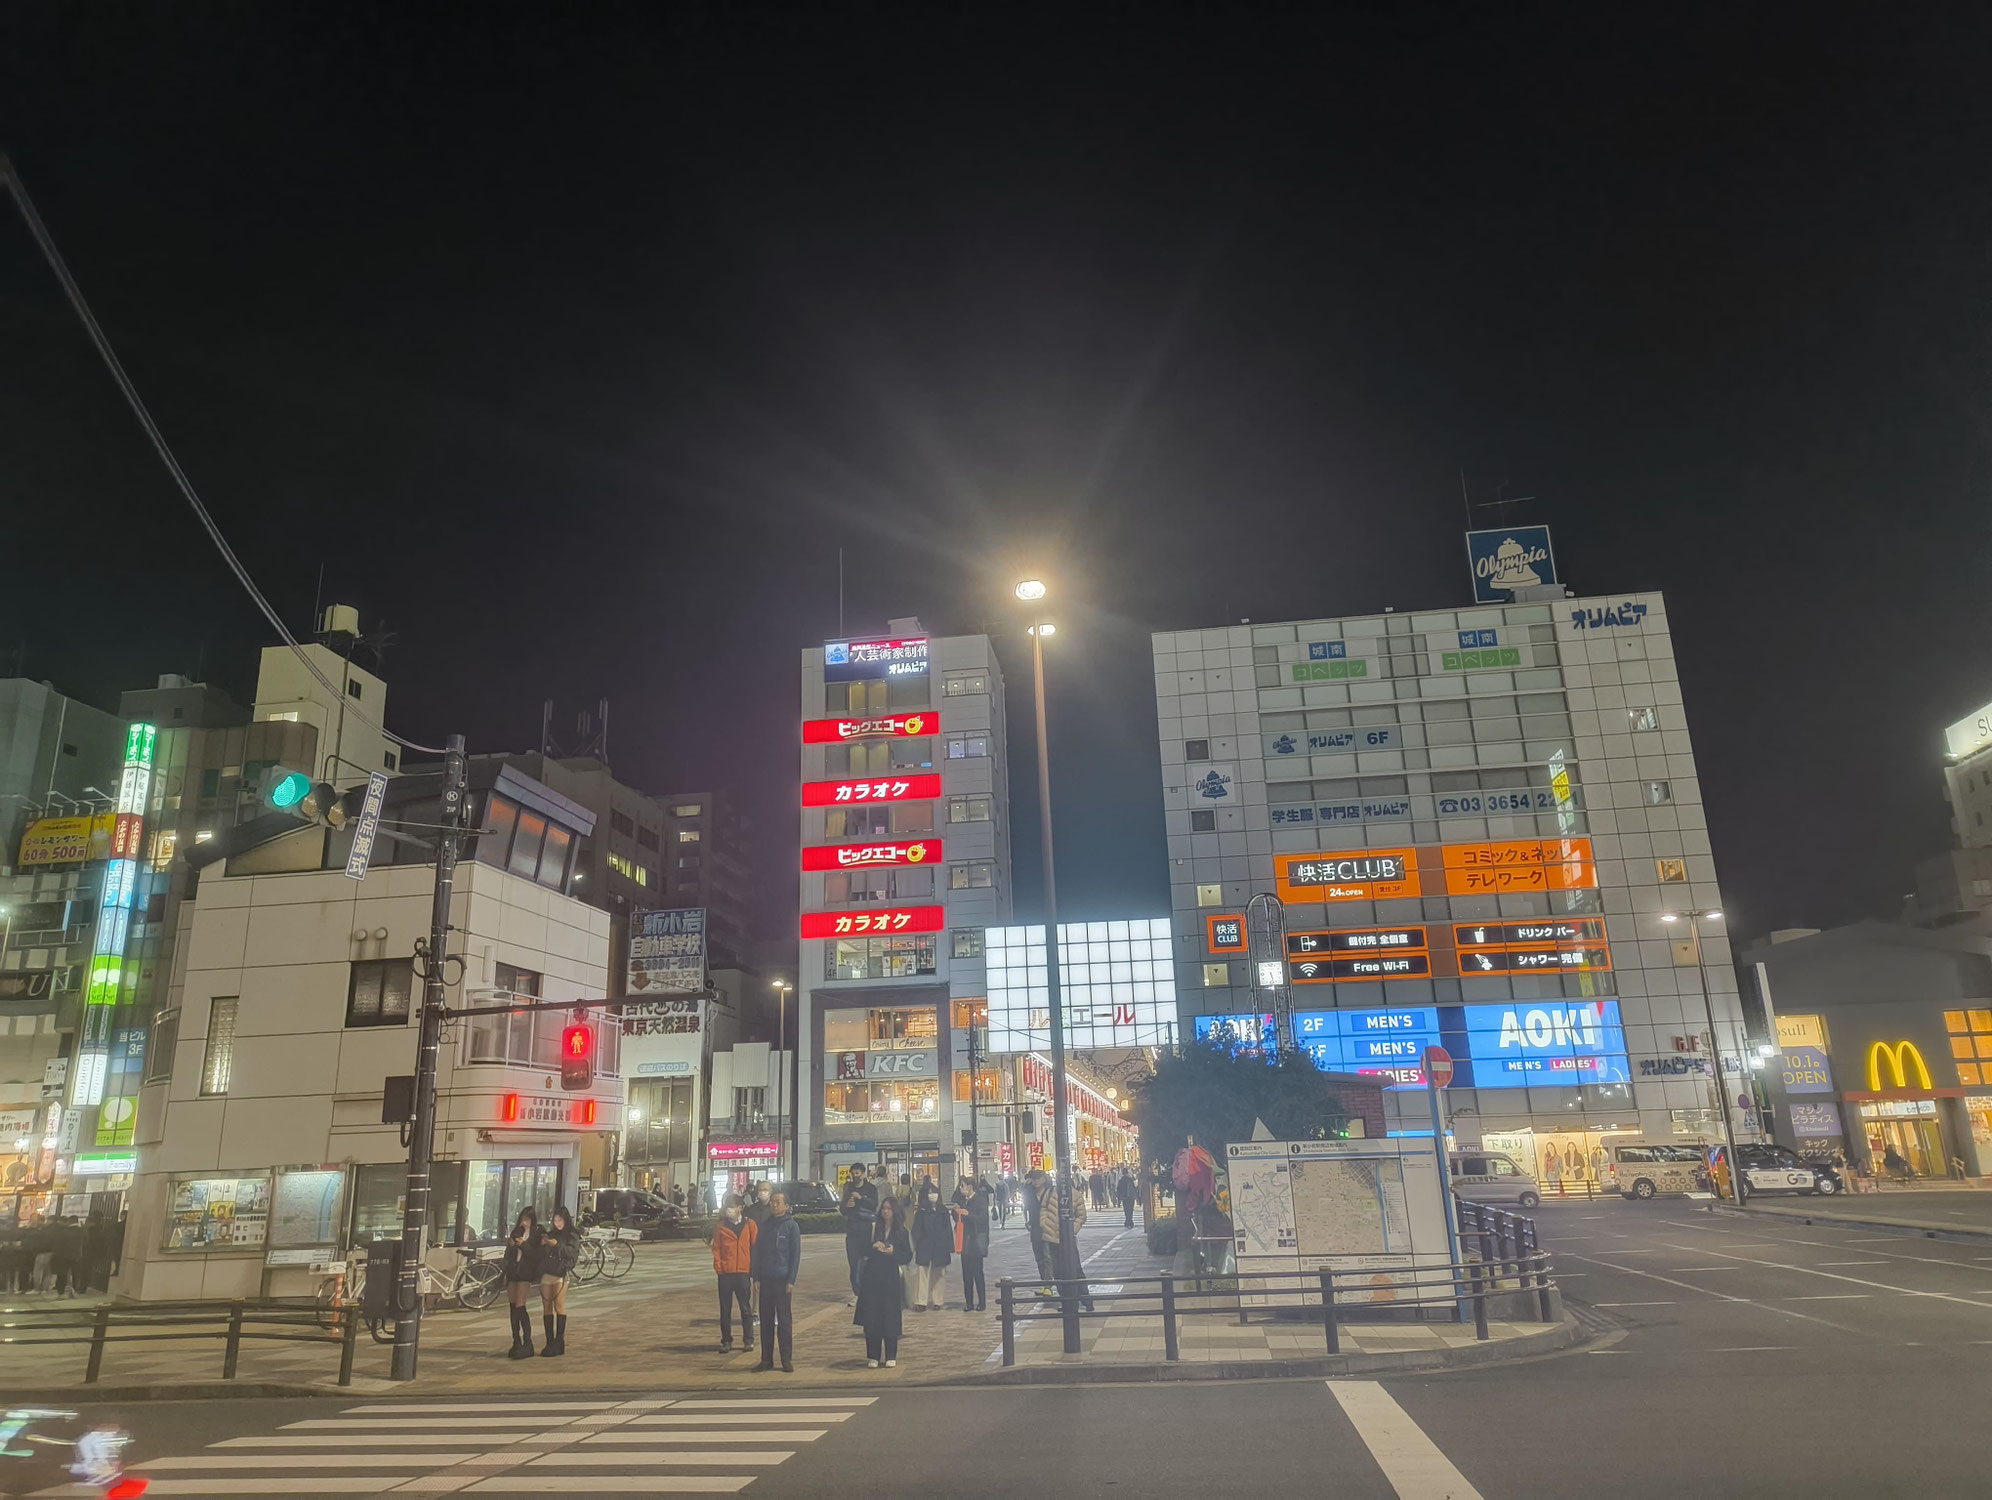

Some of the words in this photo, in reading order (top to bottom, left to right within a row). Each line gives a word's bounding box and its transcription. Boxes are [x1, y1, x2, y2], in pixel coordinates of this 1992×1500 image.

[1476, 546, 1548, 579] Olympia
[1572, 602, 1647, 629] オリムピア
[1461, 633, 1494, 645] 城南
[849, 646, 928, 662] 人芸術家制作
[1311, 645, 1342, 657] 城南
[888, 661, 927, 674] オリムピア
[838, 719, 904, 737] ビッグエコー
[1310, 734, 1353, 747] オリムピア
[1366, 731, 1389, 744] 6F
[835, 782, 909, 801] カラオケ
[1195, 774, 1231, 792] Olympia
[1460, 797, 1481, 812] 03
[1488, 794, 1530, 811] 3654
[1537, 790, 1578, 807] 221
[1271, 808, 1314, 823] 学生服
[1319, 806, 1360, 820] 専門店
[1364, 803, 1409, 816] オリムピア
[349, 778, 384, 876] 夜間点滅式
[838, 846, 906, 864] ビッグエコー
[1298, 859, 1396, 882] 快活CLUB
[1466, 870, 1542, 888] テレワーク
[643, 911, 703, 934] 新小岩
[835, 913, 911, 933] カラオケ
[1216, 924, 1237, 934] 快活
[1217, 934, 1238, 943] CLUB
[1518, 928, 1553, 938] ドリンク
[1557, 927, 1575, 936] バー
[631, 933, 701, 957] 自動車学校
[1354, 963, 1380, 972] Free
[1518, 954, 1558, 965] シャワー
[1029, 1004, 1135, 1028] ルエール
[1304, 1018, 1324, 1031] 2F
[1367, 1015, 1413, 1029] MEN'S
[622, 1016, 701, 1036] 東京天然温泉
[1499, 1008, 1595, 1047] AOKI
[120, 1031, 146, 1042] 当ビル
[129, 1044, 143, 1055] 3F
[1370, 1042, 1417, 1055] MEN'S
[872, 1054, 925, 1073] KFC
[1508, 1061, 1542, 1071] MEN'S
[1553, 1060, 1593, 1069] LADIES'
[1783, 1070, 1827, 1085] OPEN
[1487, 1138, 1522, 1150] 下取り
[1805, 1139, 1828, 1147] キック
